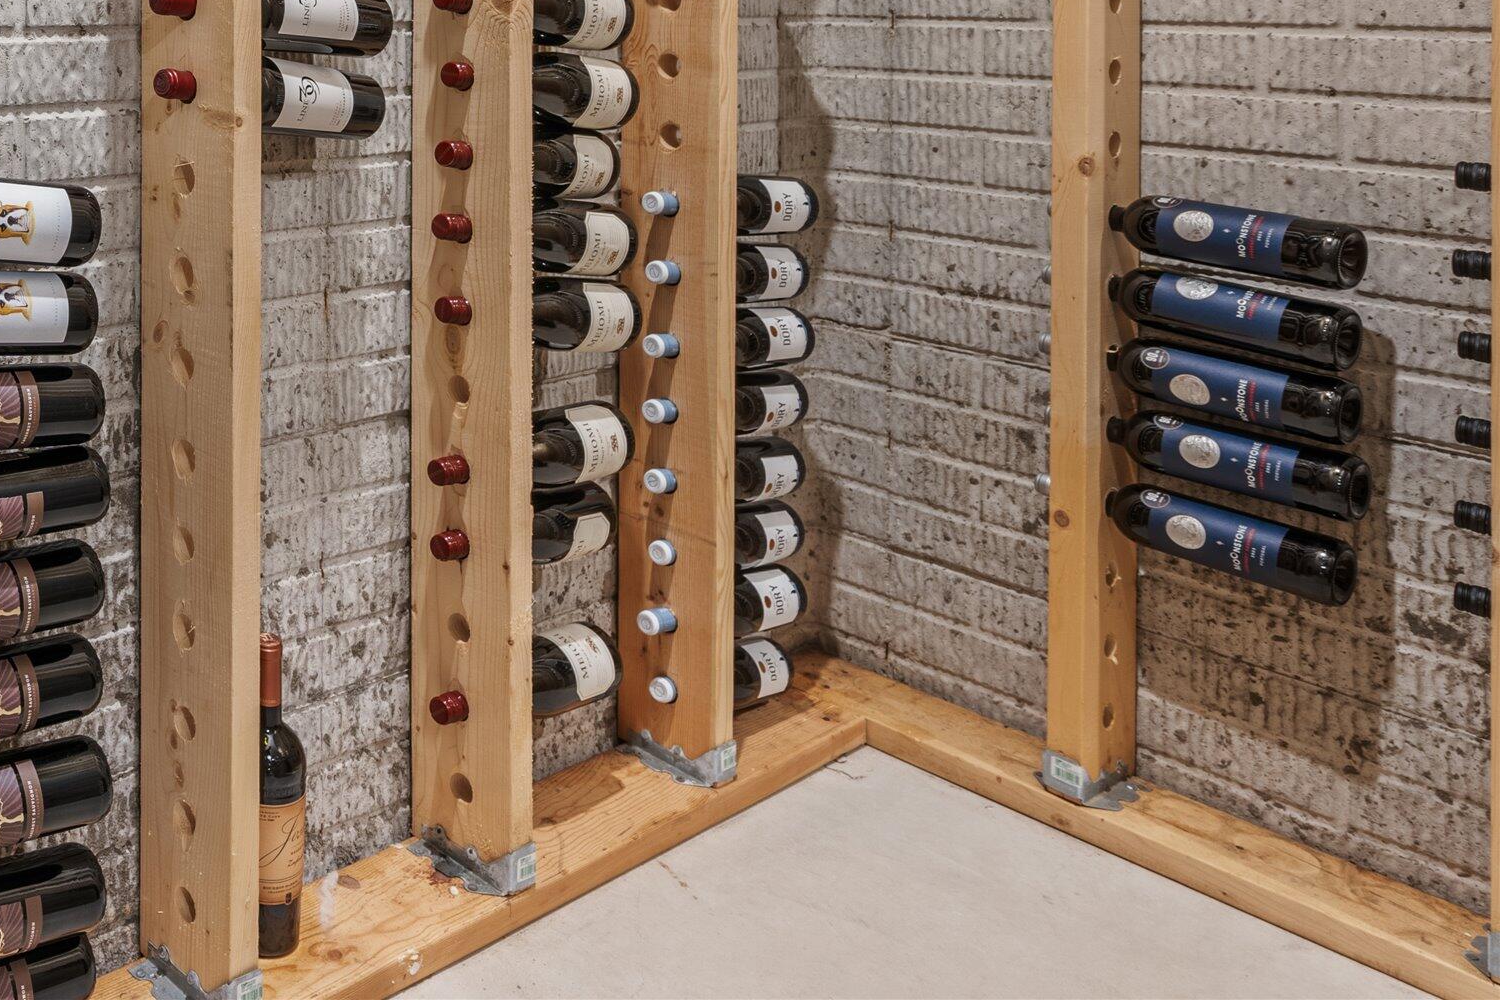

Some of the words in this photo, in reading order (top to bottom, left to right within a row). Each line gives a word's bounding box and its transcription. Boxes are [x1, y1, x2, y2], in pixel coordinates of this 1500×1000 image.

[589, 69, 606, 119] MEIOMI
[782, 192, 792, 222] DORY
[1235, 213, 1257, 258] MOONSTONE
[778, 258, 789, 288] DORY
[586, 299, 604, 348] MEIOMI
[776, 316, 791, 346] DORY
[1235, 379, 1249, 422] MOONSTONE
[582, 421, 598, 474] MEIOMI
[1244, 441, 1263, 489] MOONSTONE
[775, 527, 786, 556] DORY
[1229, 524, 1248, 571] MOONSTONE
[768, 584, 783, 616] DORY
[759, 651, 777, 682] DORY
